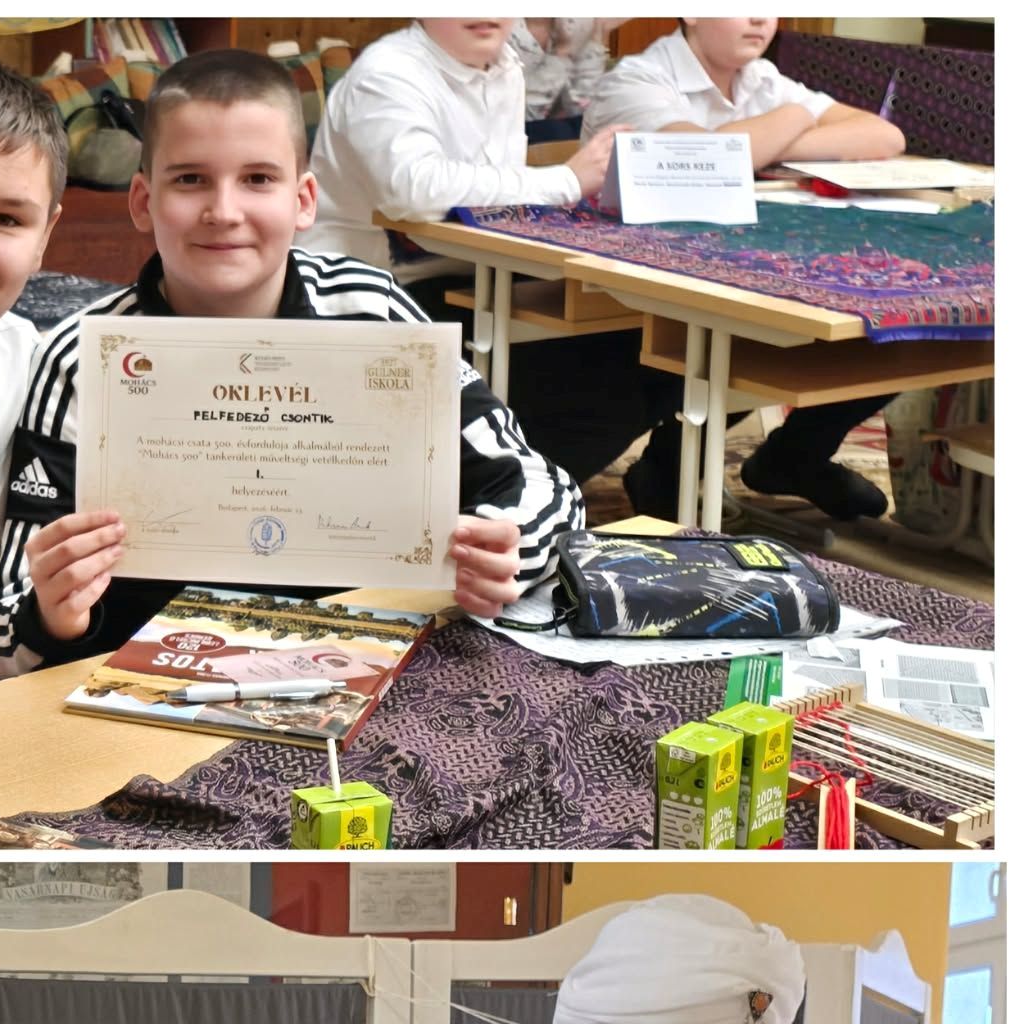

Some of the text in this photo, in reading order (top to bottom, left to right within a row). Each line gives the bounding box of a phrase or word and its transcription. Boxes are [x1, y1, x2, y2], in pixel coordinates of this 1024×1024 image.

[120, 378, 157, 387] MOHÁCS
[367, 378, 410, 389] ISKOLA
[127, 386, 149, 395] 500
[212, 381, 317, 404] OKLEVÉL
[281, 412, 334, 424] CSONTIK
[137, 435, 144, 446] A
[187, 439, 211, 448] csata
[345, 441, 390, 453] rendezett
[10, 480, 57, 499] adidas
